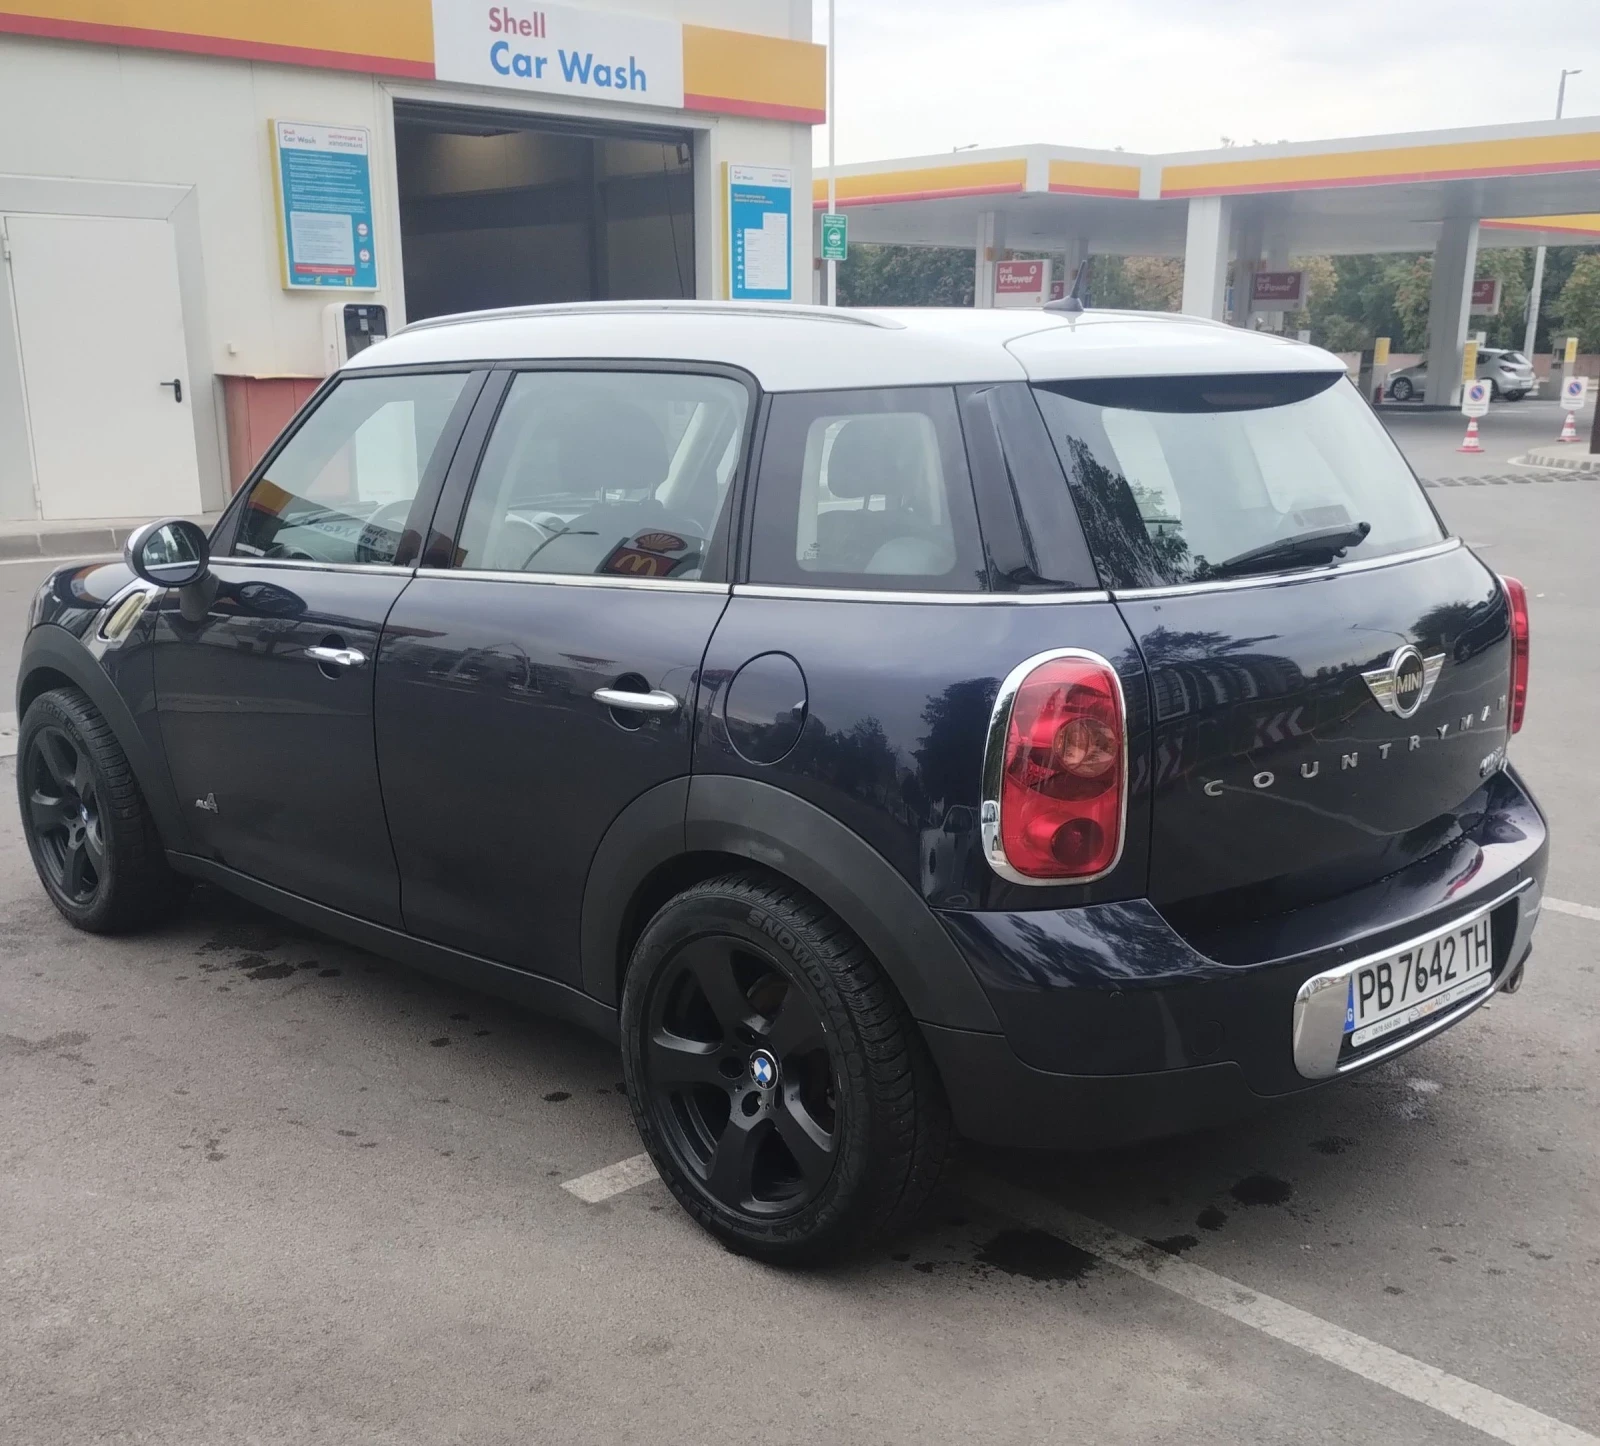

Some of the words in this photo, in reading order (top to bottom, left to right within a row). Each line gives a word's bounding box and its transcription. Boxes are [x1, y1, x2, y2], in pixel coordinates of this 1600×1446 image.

[488, 7, 546, 38] Shell
[490, 41, 548, 79] Car
[558, 49, 646, 91] Wash
[297, 136, 317, 145] Wash
[999, 275, 1034, 284] V-Power
[1396, 670, 1423, 694] MINI
[1203, 694, 1507, 797] COUNTRYMAN
[1358, 962, 1395, 1019] PB
[1398, 936, 1457, 1002] 7642
[1460, 920, 1488, 972] TH
